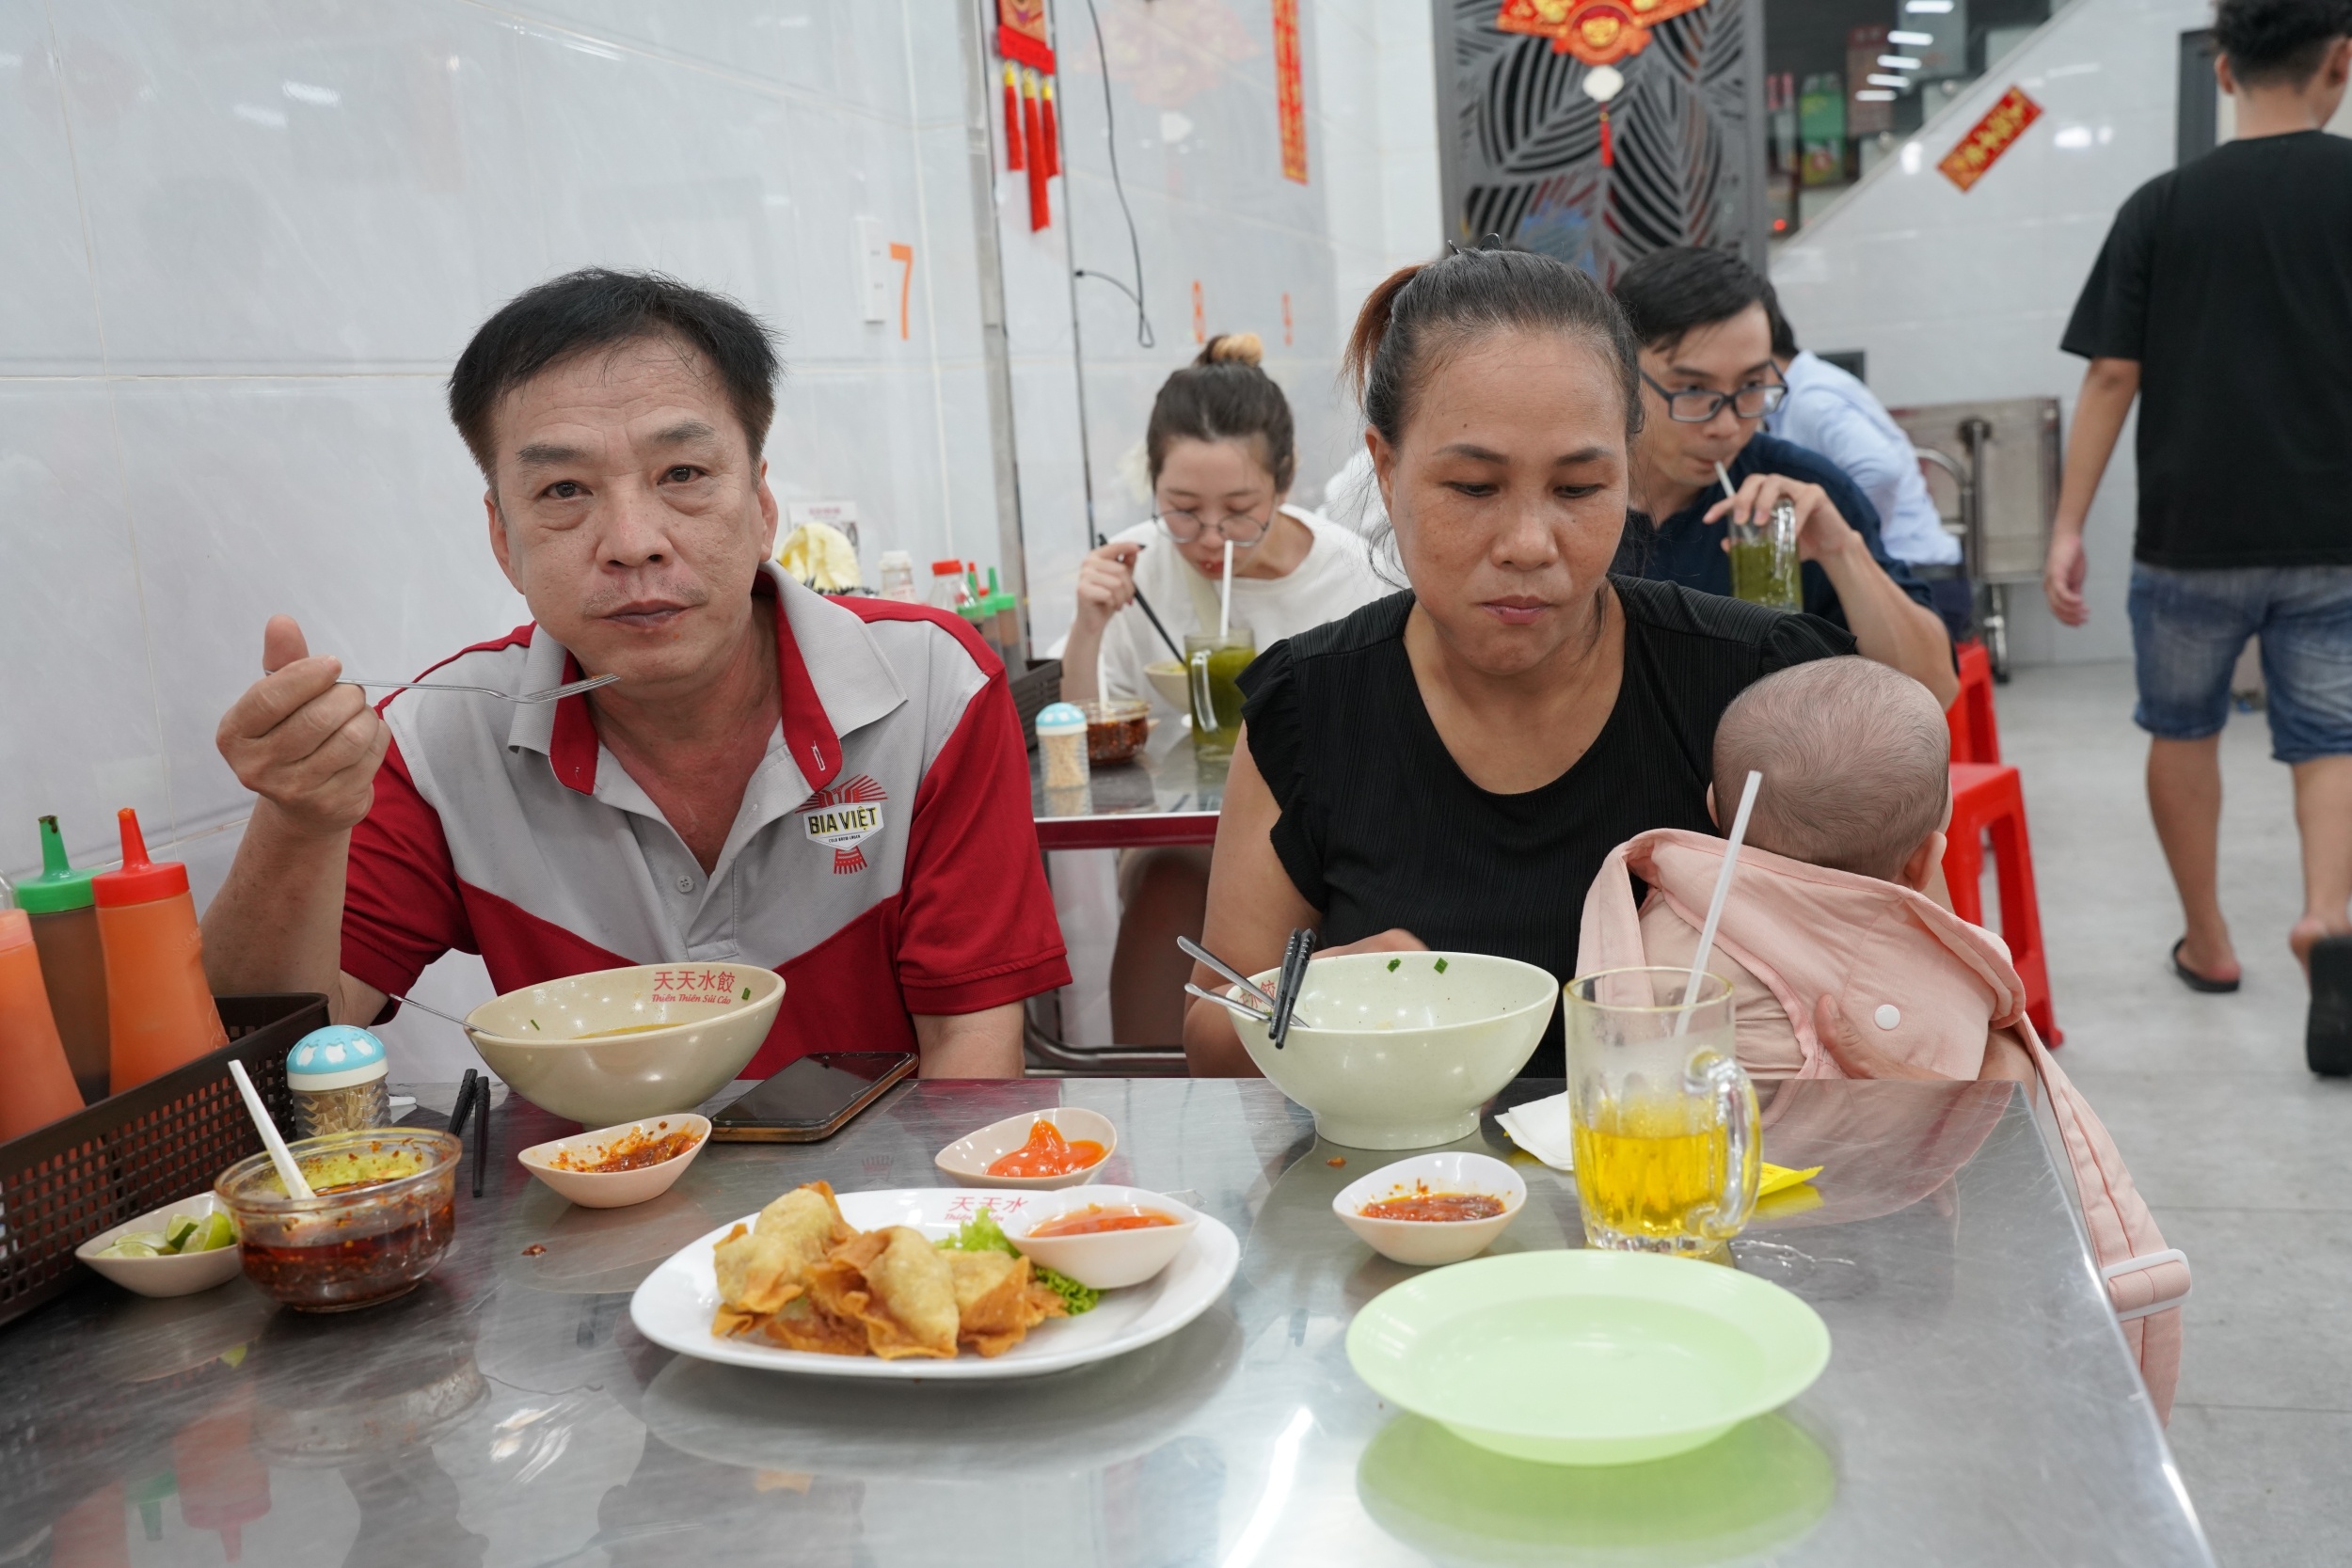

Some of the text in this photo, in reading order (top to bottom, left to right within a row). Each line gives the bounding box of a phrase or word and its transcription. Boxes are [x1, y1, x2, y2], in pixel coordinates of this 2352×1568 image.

[889, 241, 914, 341] 7
[808, 806, 877, 834] BIA VIỆT
[654, 970, 736, 993] 天天水餃
[652, 993, 675, 1002] Thiên
[678, 993, 701, 1003] Thiên
